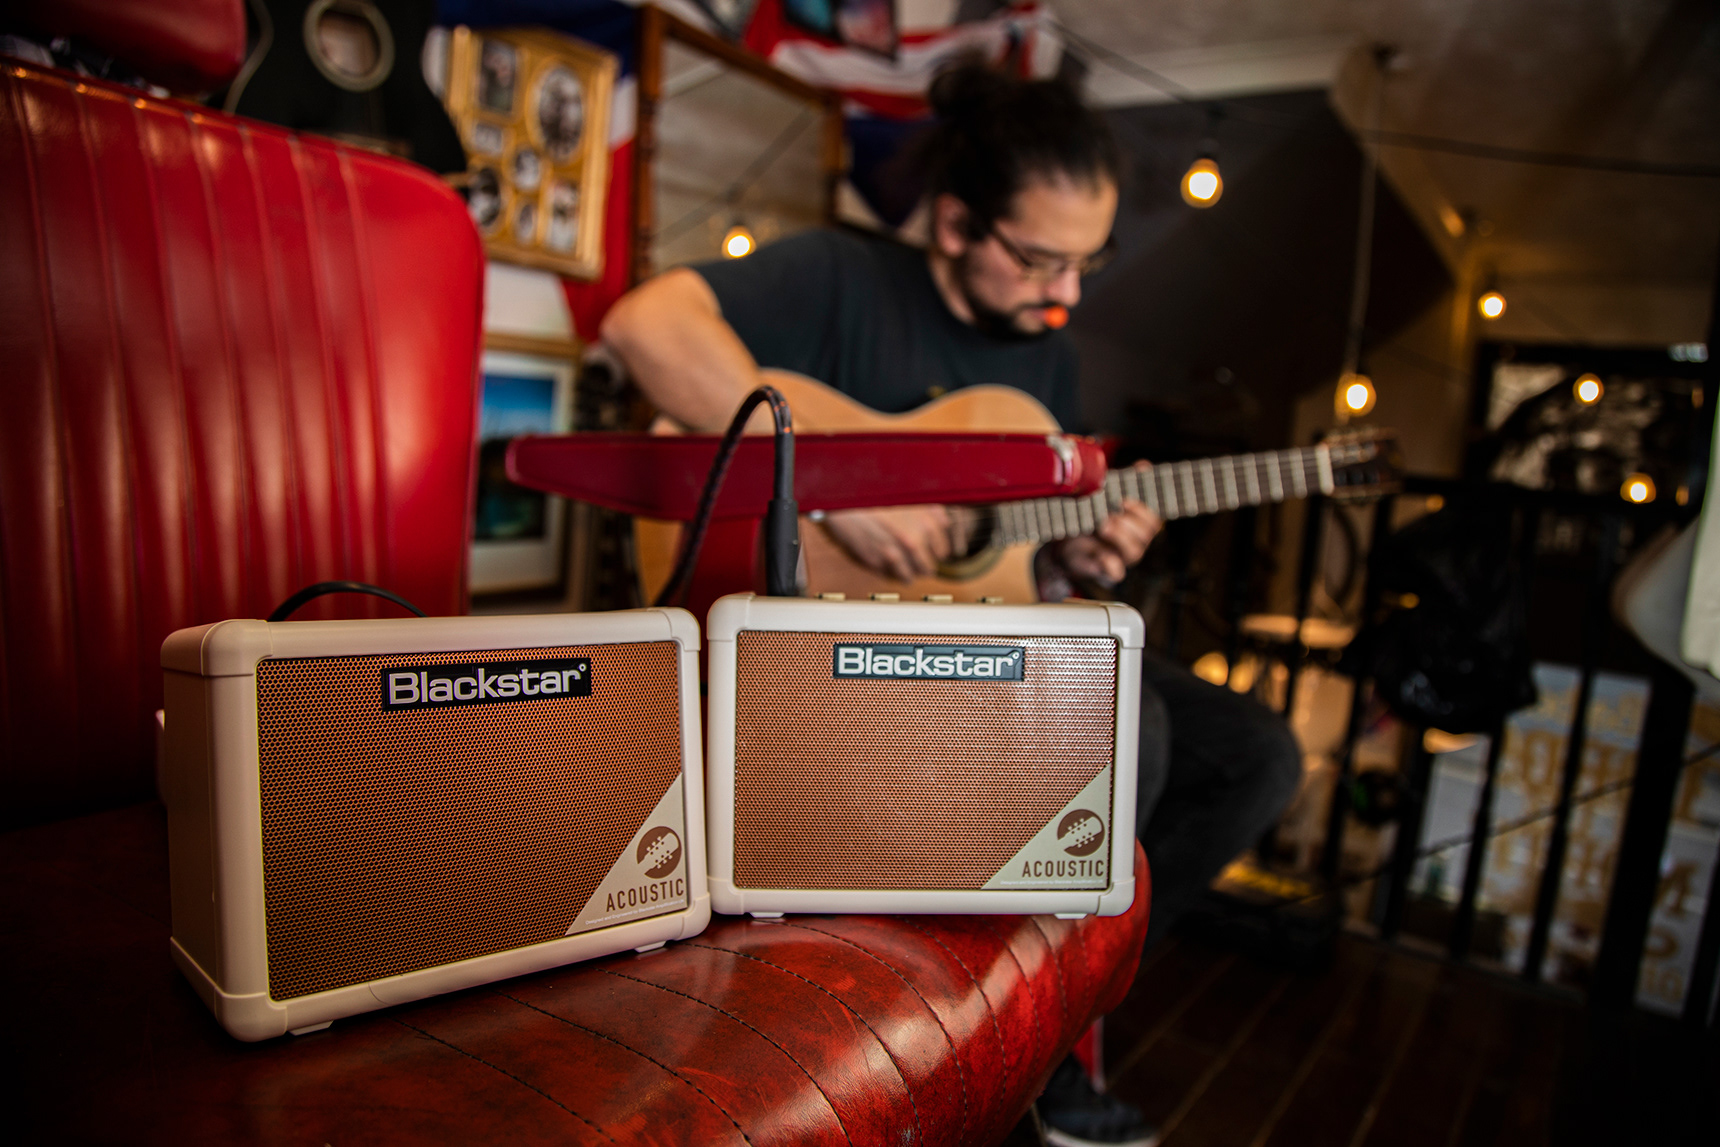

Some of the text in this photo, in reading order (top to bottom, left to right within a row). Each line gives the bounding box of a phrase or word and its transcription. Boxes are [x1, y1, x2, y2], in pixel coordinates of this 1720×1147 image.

[838, 646, 1014, 677] Blackstar
[388, 667, 582, 705] Blackstar
[1021, 860, 1105, 878] ACOUSTIC
[606, 878, 684, 912] ACOUSTIC
